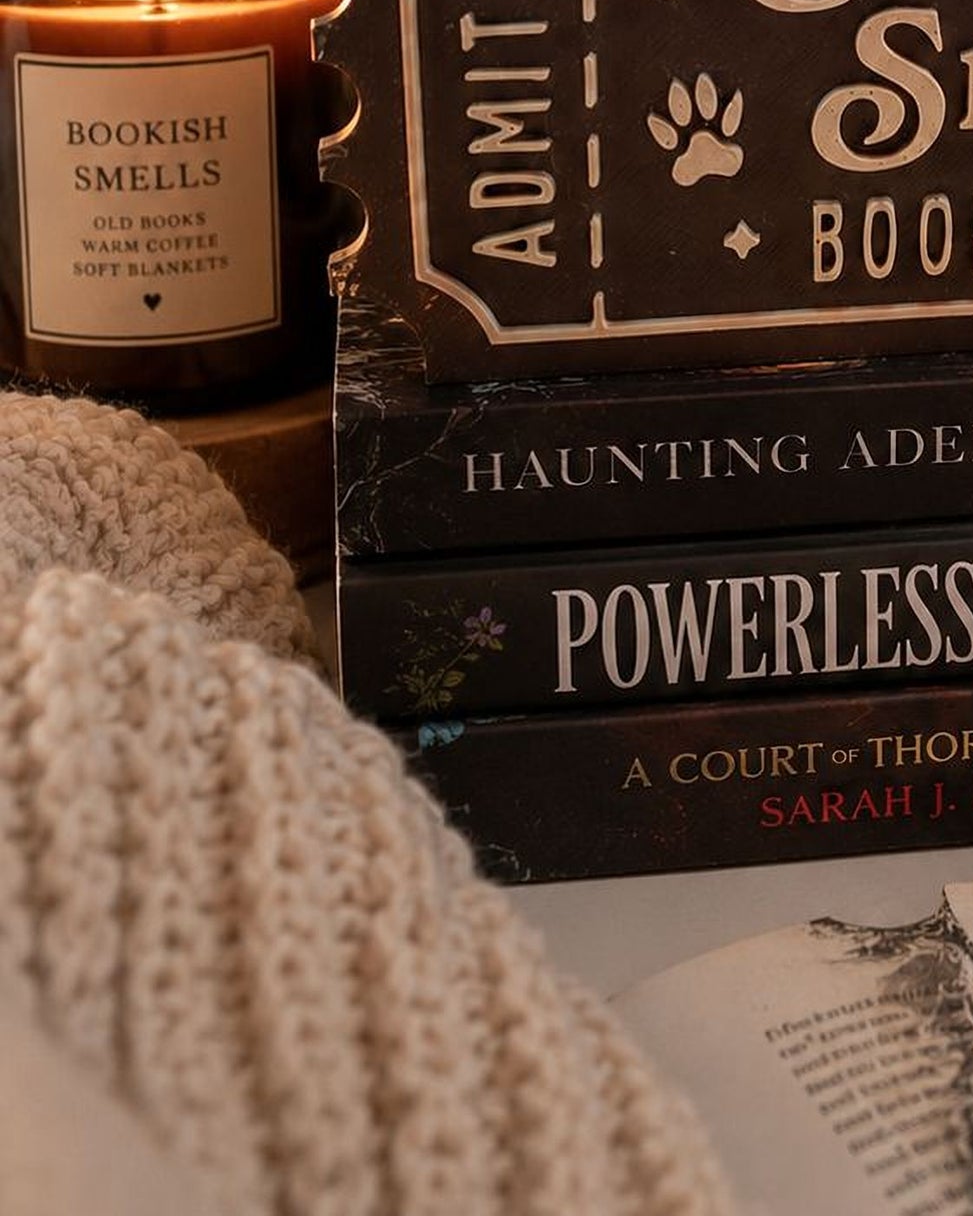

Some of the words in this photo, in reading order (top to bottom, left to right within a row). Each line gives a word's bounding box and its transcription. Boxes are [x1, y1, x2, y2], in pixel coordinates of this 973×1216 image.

[67, 116, 228, 146] BOOKISH
[461, 11, 556, 267] ADMIT
[74, 160, 223, 192] SMELLS
[93, 215, 133, 230] OLD
[140, 212, 206, 229] BOOKS
[82, 239, 139, 253] WARM
[145, 233, 219, 253] COFFEE
[73, 262, 120, 277] SOFT
[127, 255, 229, 276] BLANKETS
[464, 433, 808, 493] HAUNTING
[622, 758, 653, 790] A
[669, 742, 824, 784] COURT
[831, 748, 859, 765] OF
[761, 786, 911, 828] SARAH
[930, 781, 955, 819] J.
